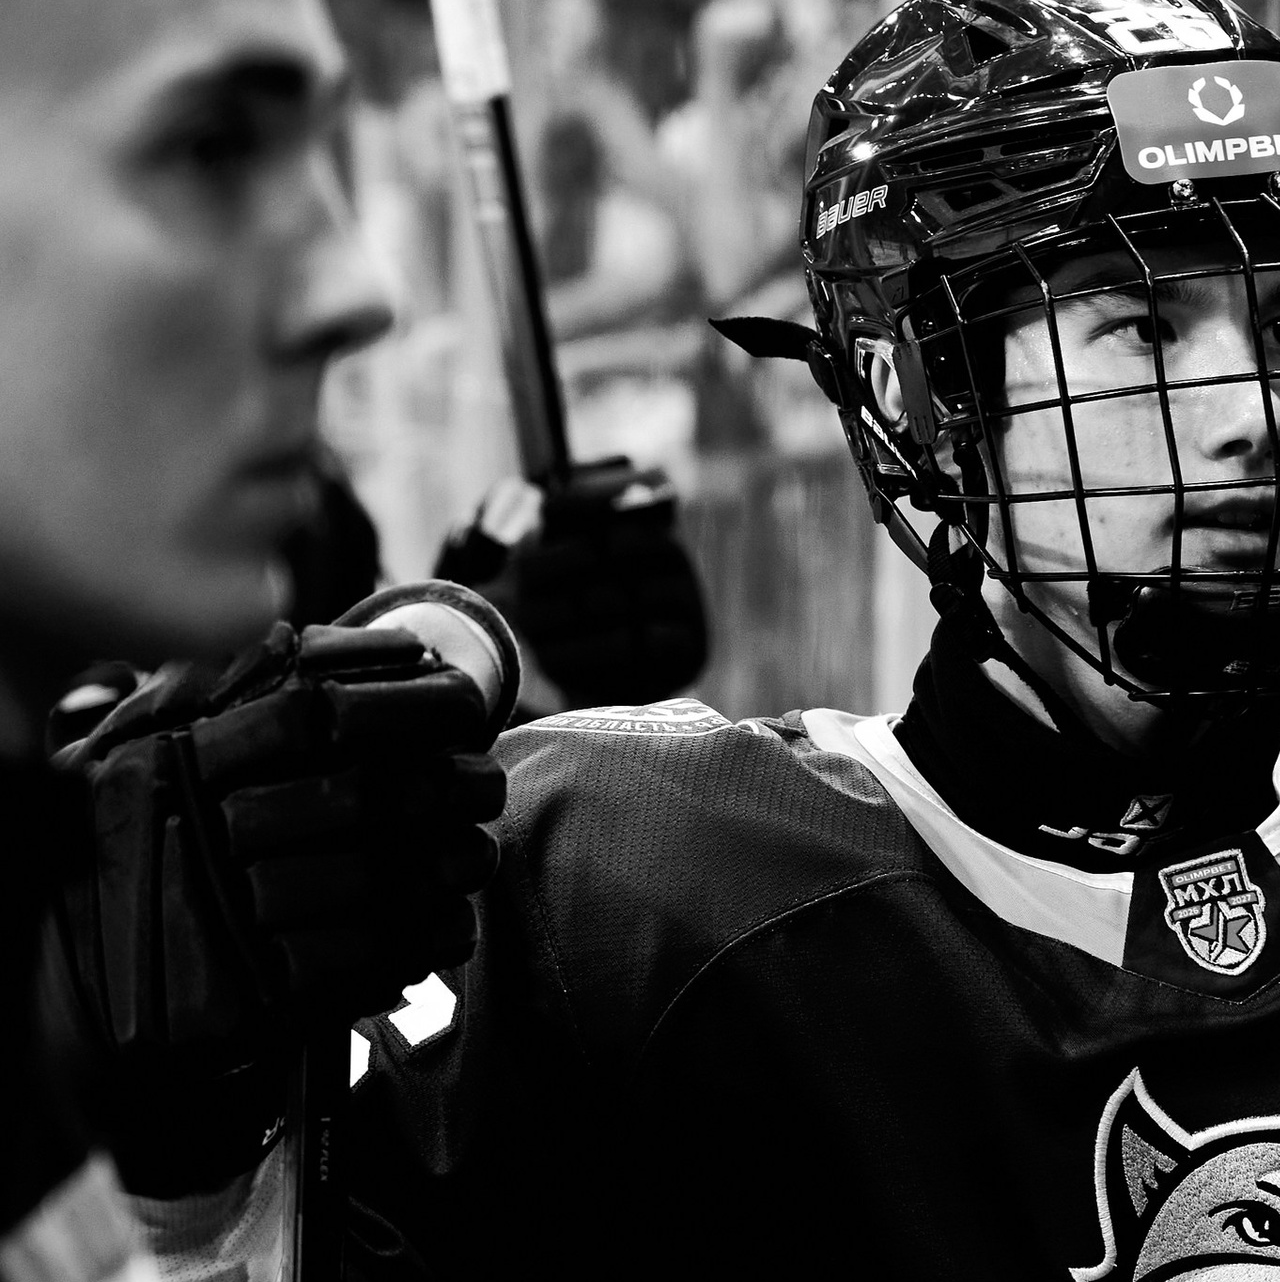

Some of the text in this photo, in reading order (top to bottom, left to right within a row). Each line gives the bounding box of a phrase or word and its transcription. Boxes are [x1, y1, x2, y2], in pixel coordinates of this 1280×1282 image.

[574, 718, 677, 732] ОБЛАСТЬ
[1175, 862, 1233, 884] OLIMPBET
[1172, 873, 1243, 907] МХЛ
[1230, 894, 1252, 906] 2027
[1177, 906, 1200, 919] 2026
